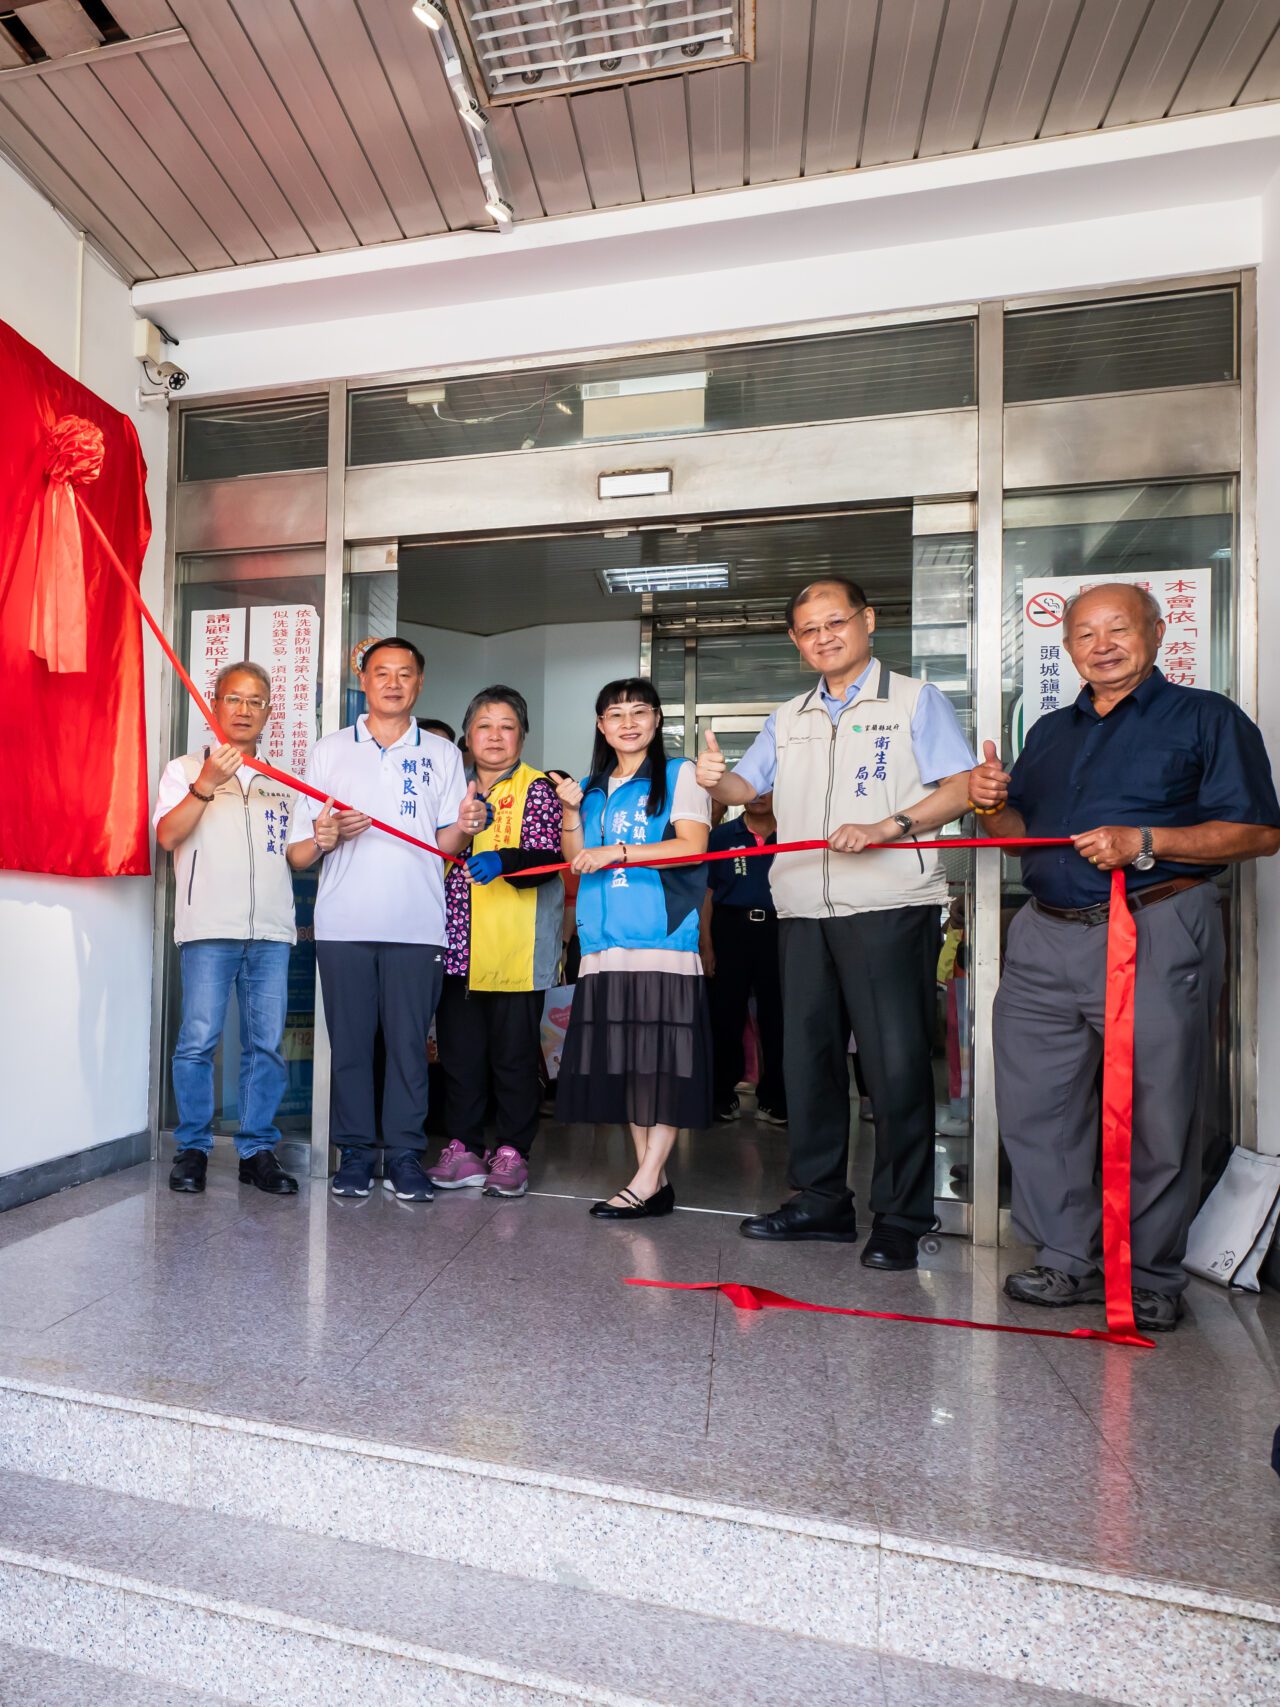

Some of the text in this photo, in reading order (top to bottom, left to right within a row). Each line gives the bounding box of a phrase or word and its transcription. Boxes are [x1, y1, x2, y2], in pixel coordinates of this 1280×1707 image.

[1039, 645, 1061, 710] 頭城鎮農
[854, 765, 869, 798] 局長
[872, 735, 891, 781] 衛生局
[400, 758, 419, 819] 賴良洲
[632, 794, 649, 845] 頭城鎮
